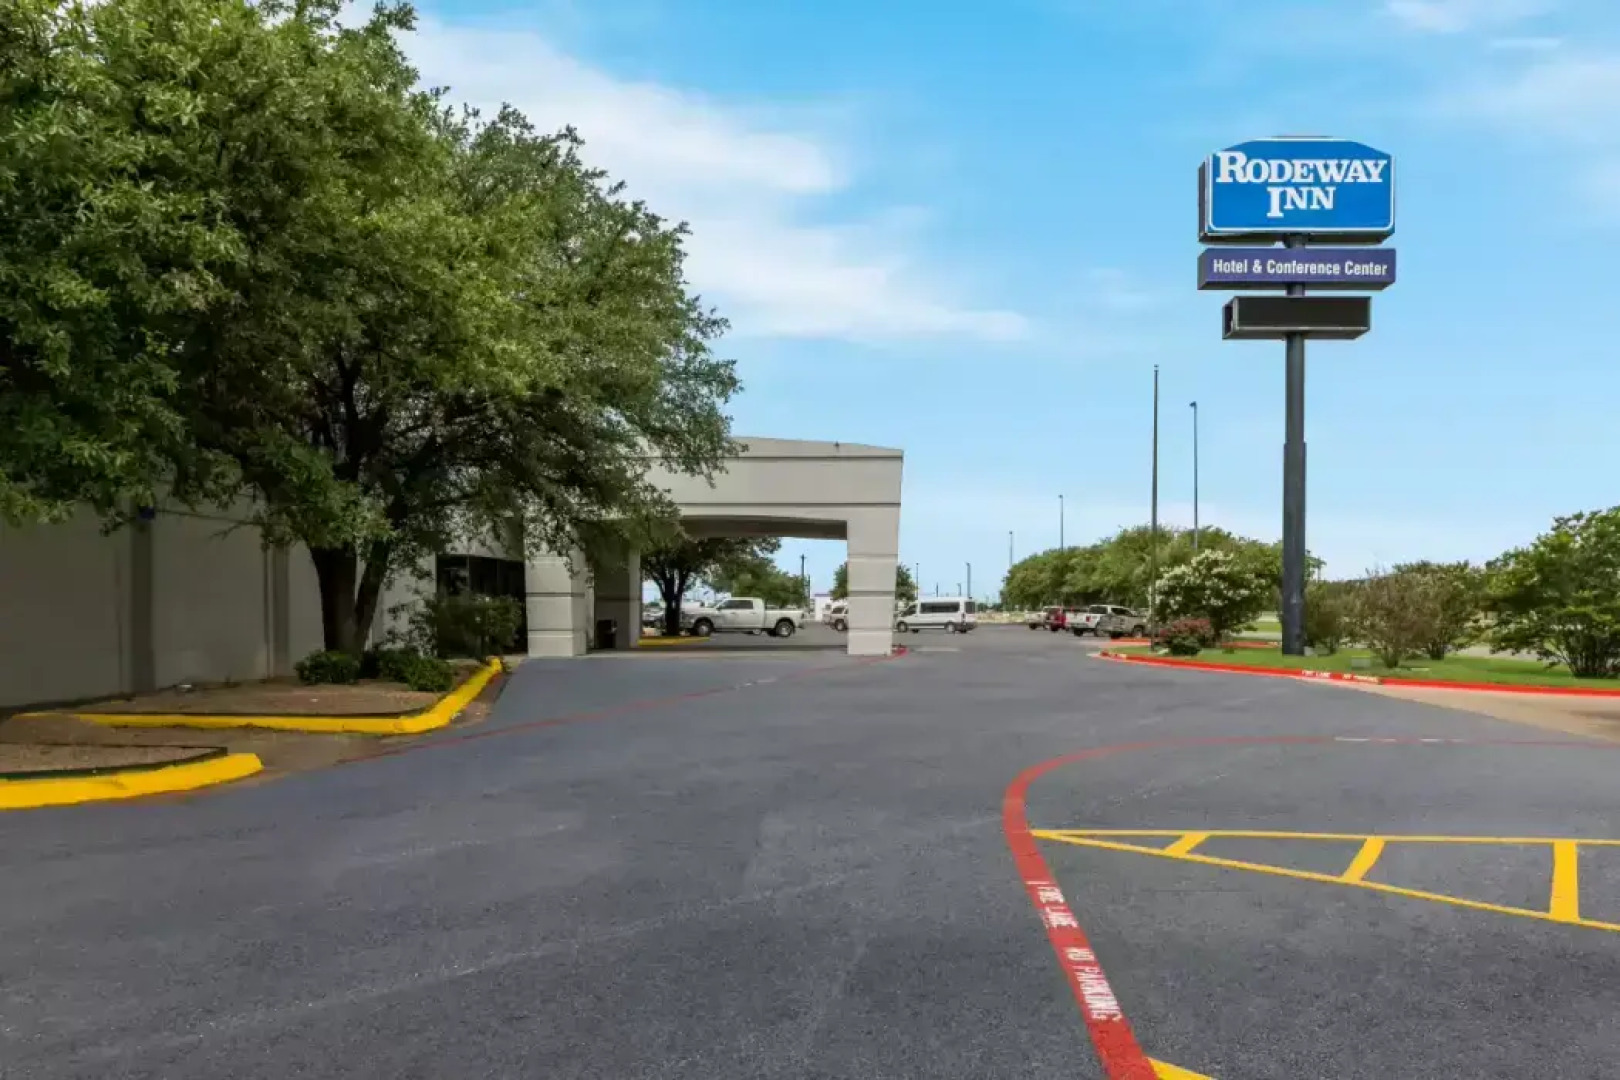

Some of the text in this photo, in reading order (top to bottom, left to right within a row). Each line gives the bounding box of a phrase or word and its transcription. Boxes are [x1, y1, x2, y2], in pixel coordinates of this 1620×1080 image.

[1216, 151, 1388, 183] RODEWAY
[1266, 187, 1336, 218] INN
[1213, 259, 1388, 276] Hotel & Conference Center
[1072, 965, 1124, 1022] PARKING
